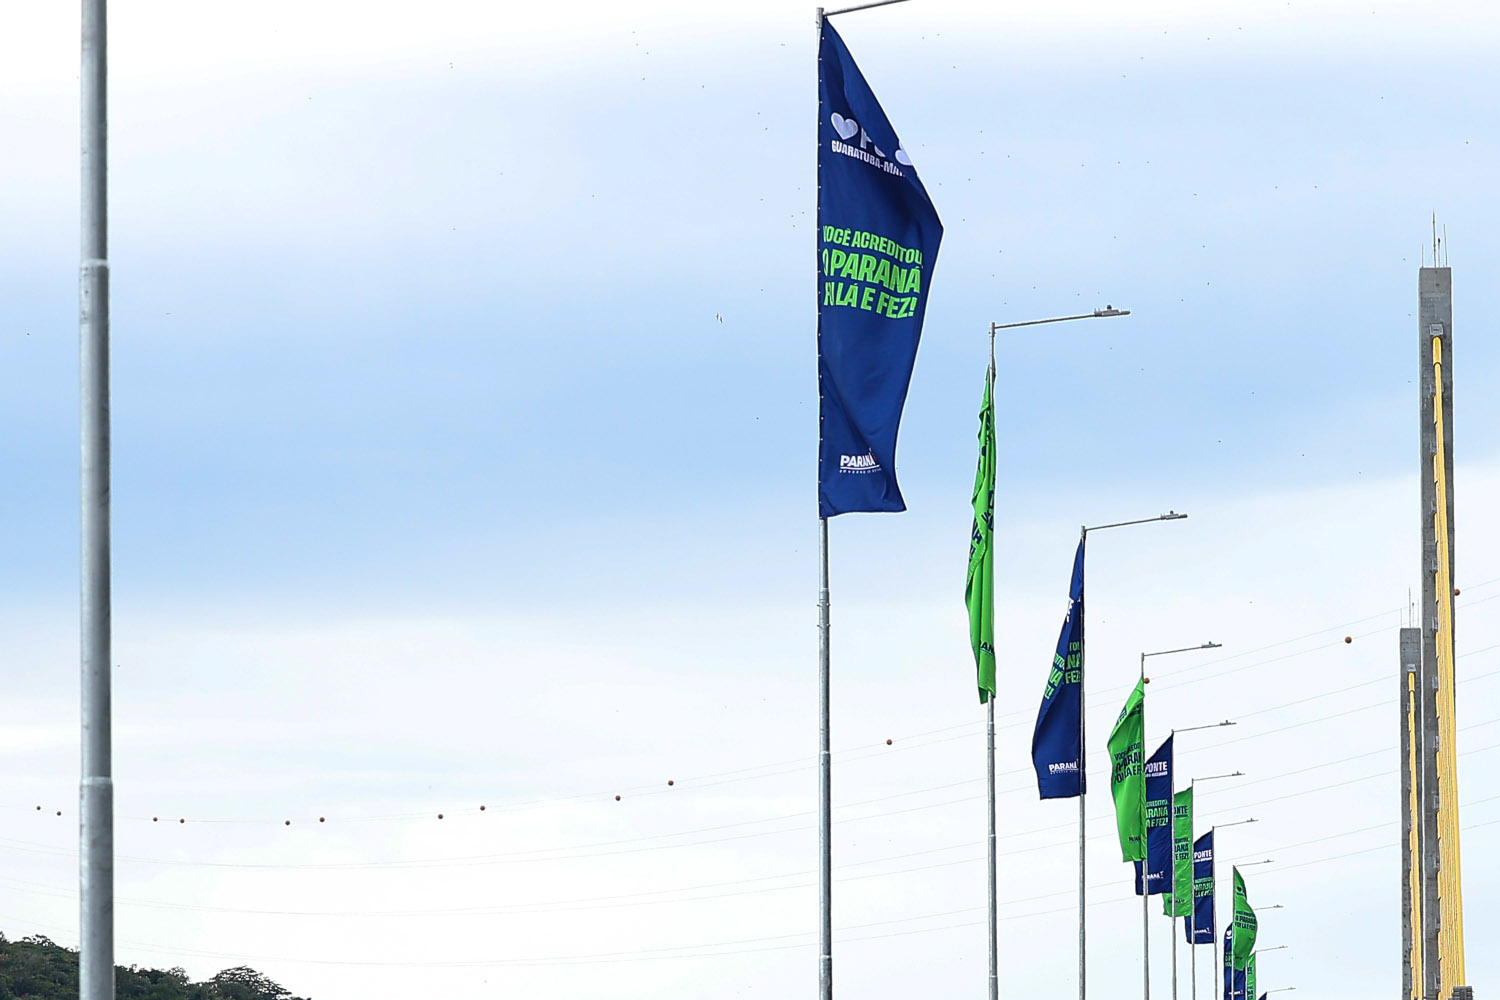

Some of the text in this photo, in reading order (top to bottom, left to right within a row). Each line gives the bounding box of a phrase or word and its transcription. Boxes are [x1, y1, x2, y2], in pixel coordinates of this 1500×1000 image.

[830, 248, 921, 294] PARANÁ
[835, 281, 858, 308] LÁ
[860, 287, 876, 311] E
[876, 291, 918, 319] FEZ!
